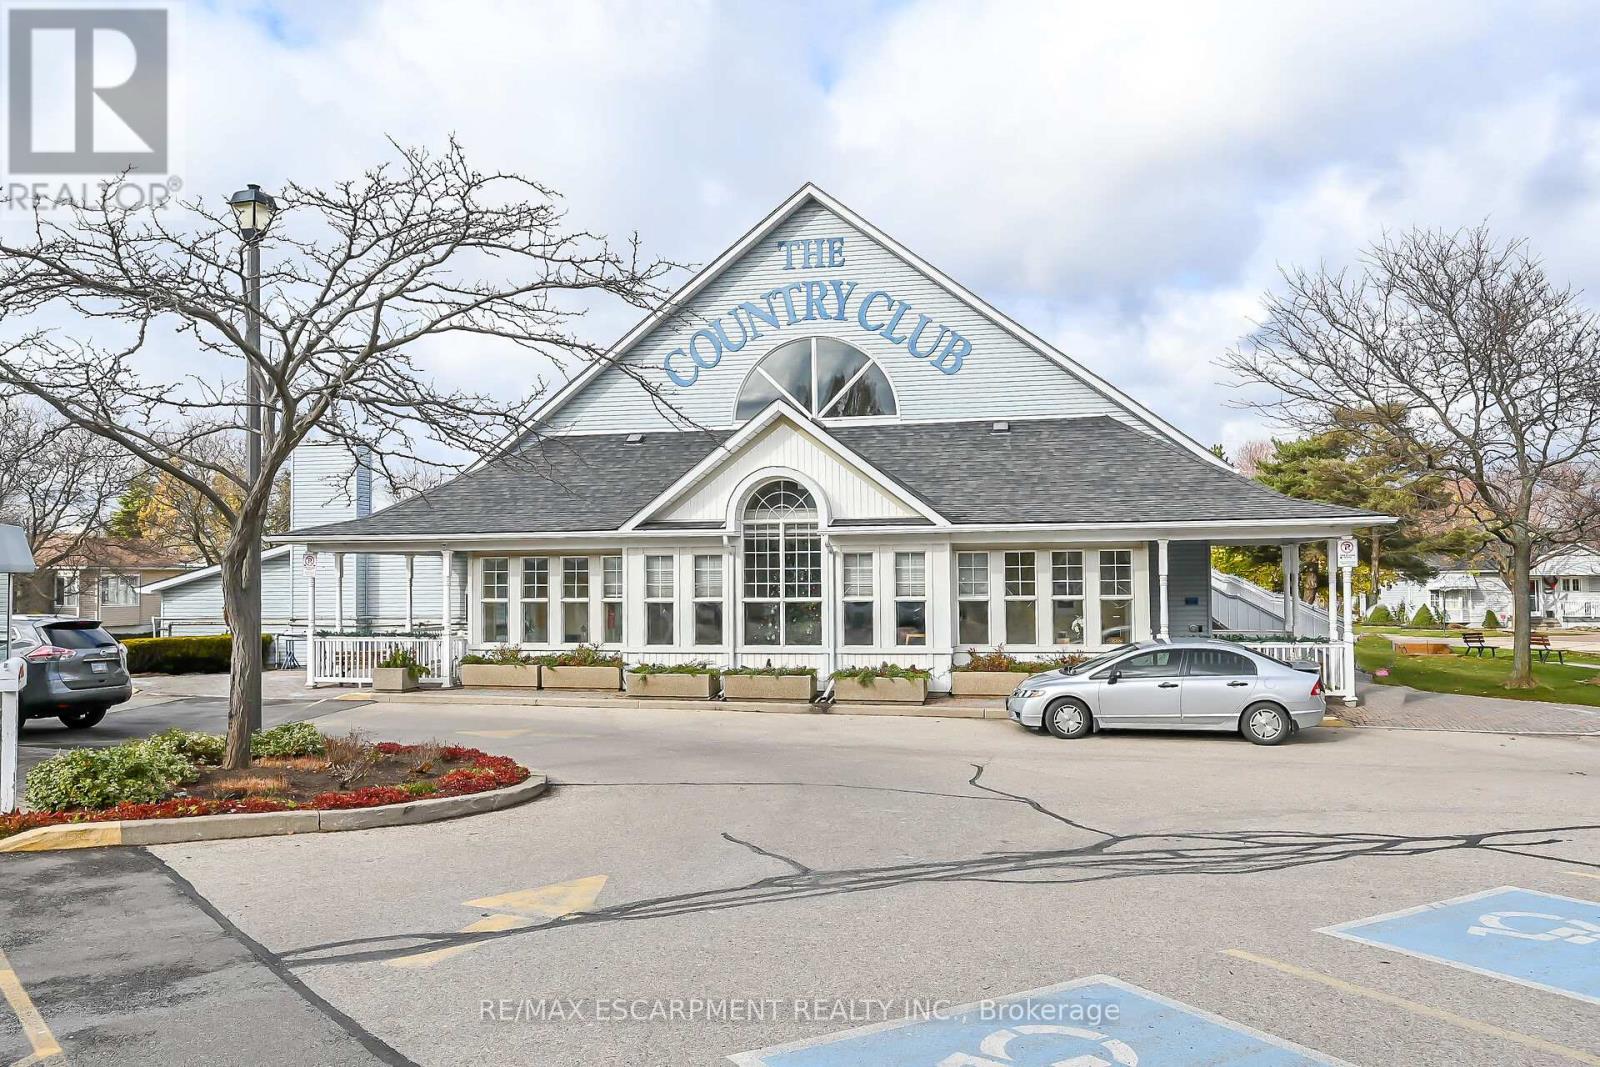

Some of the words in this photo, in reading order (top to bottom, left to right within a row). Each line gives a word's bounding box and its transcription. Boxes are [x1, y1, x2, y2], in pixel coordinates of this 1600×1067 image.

[778, 237, 845, 270] THE
[663, 279, 858, 387] COUNTRY
[858, 290, 973, 375] CLUB
